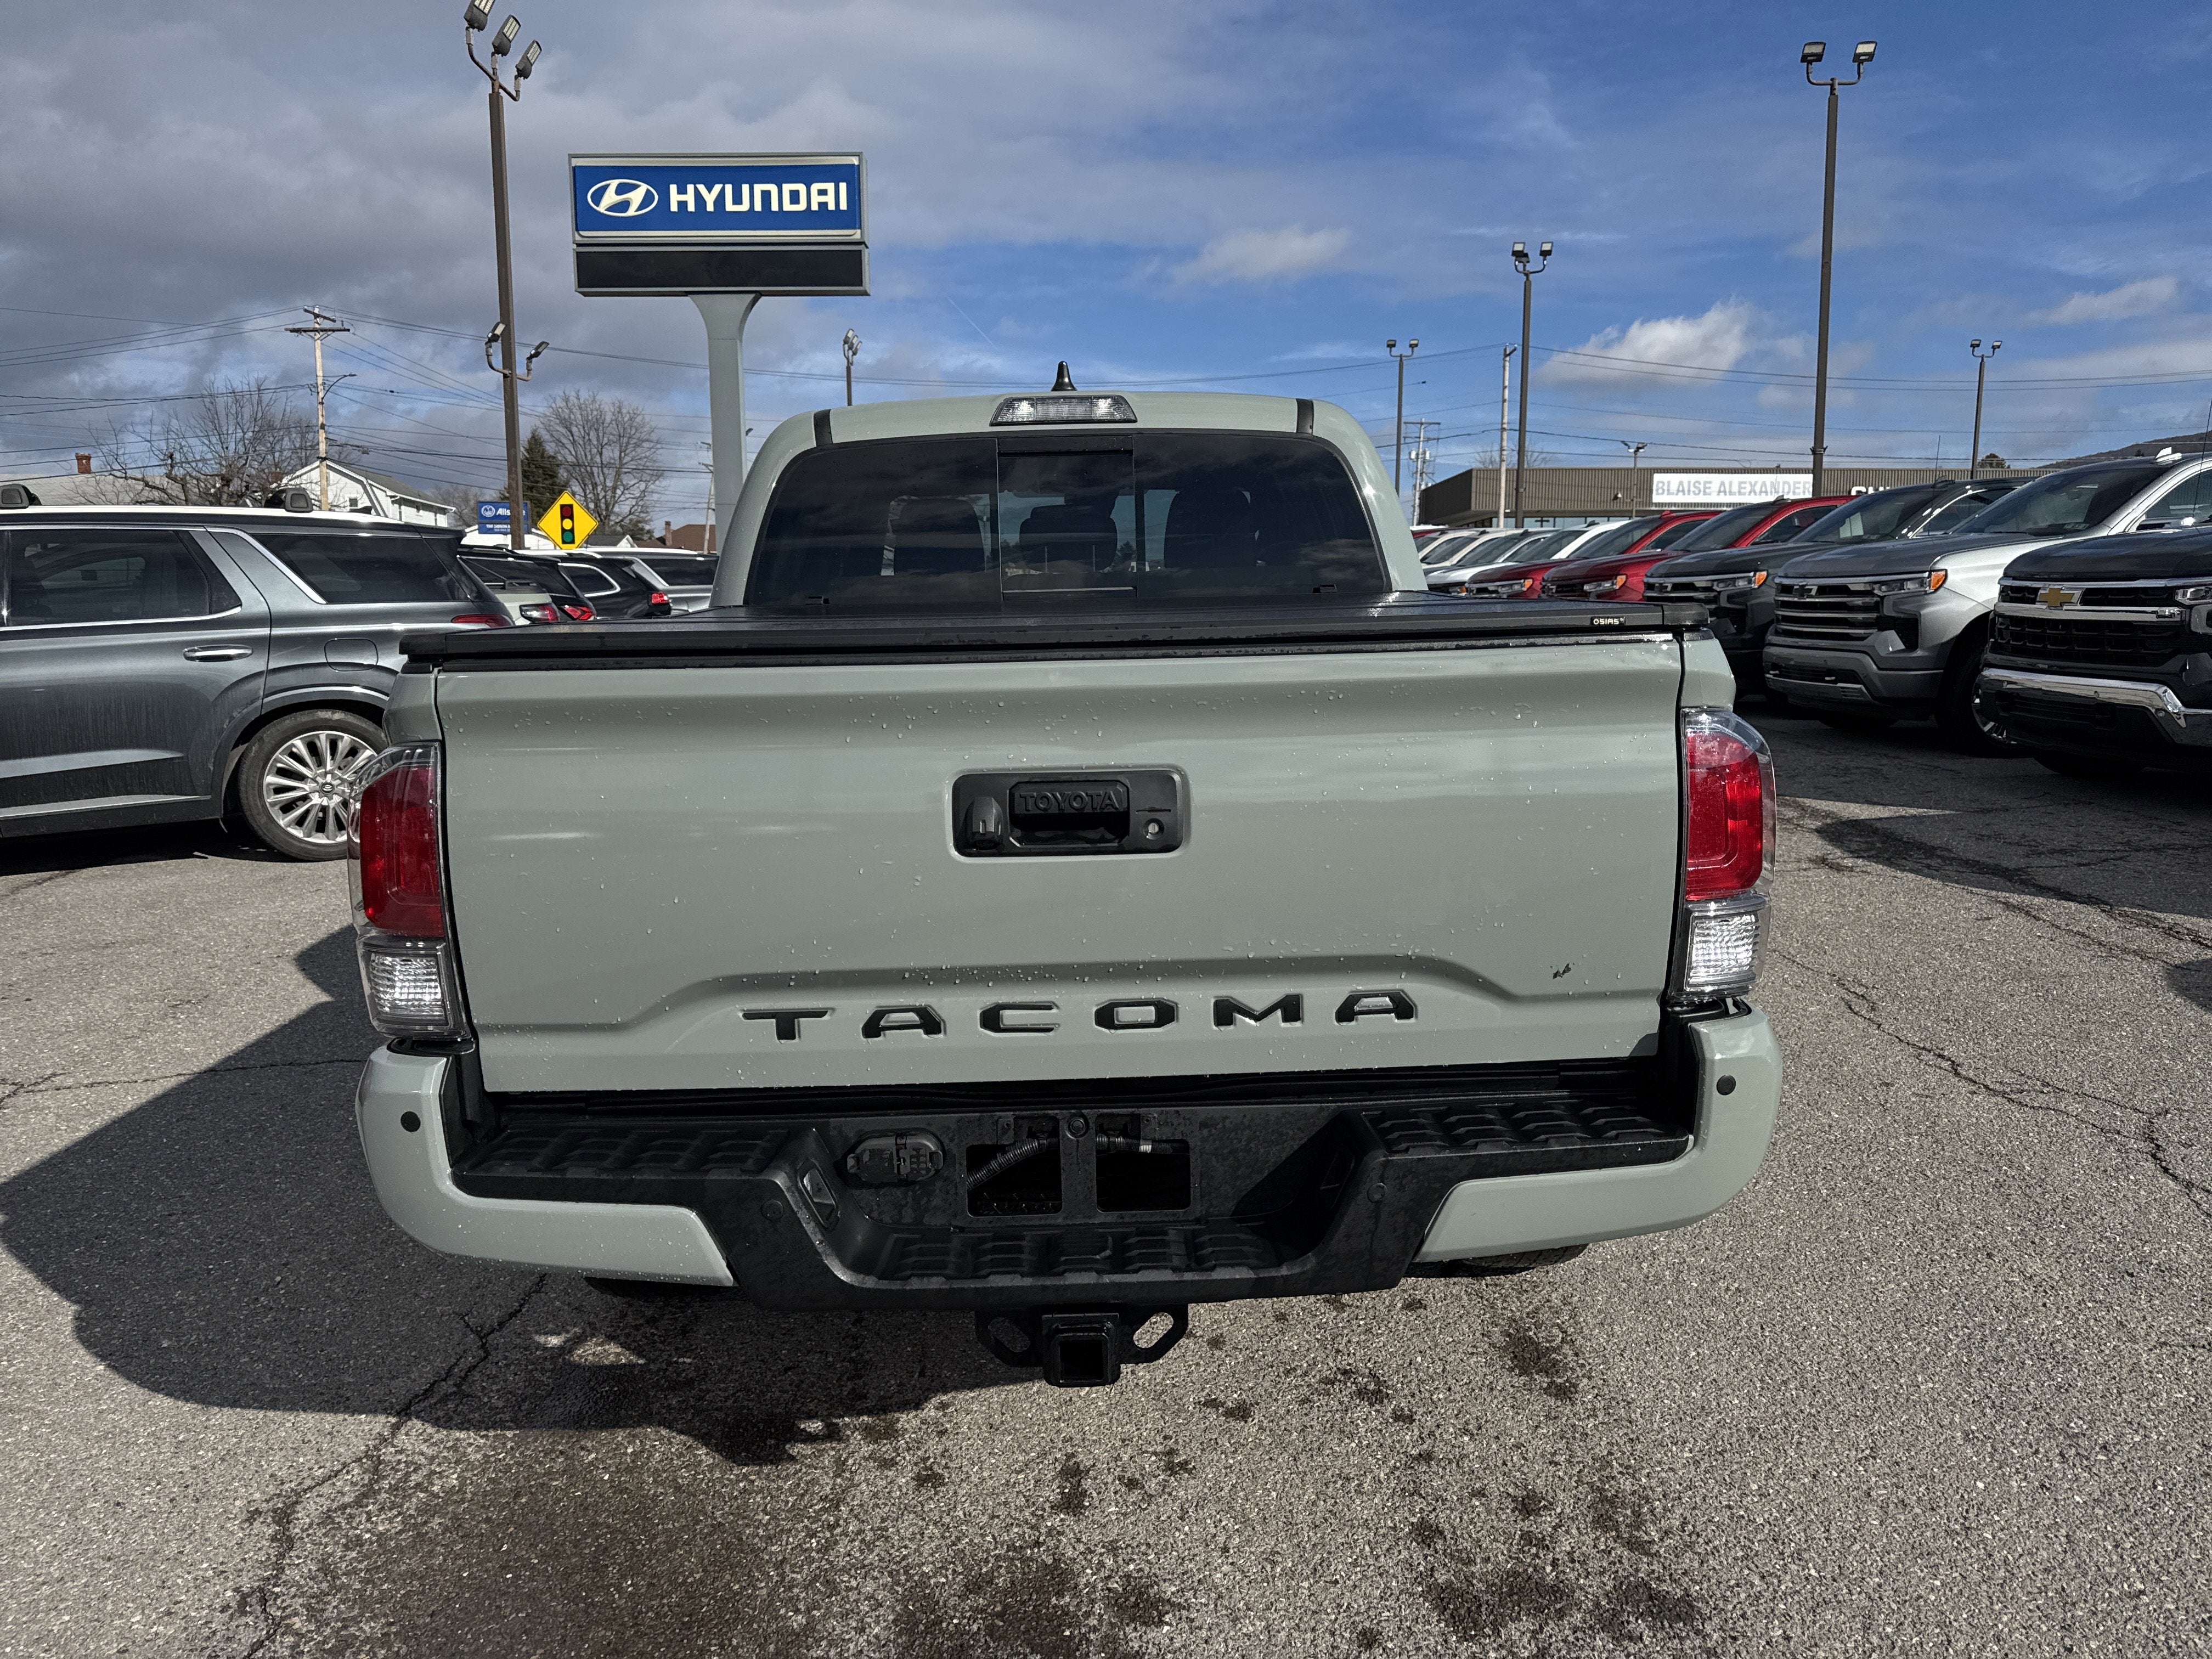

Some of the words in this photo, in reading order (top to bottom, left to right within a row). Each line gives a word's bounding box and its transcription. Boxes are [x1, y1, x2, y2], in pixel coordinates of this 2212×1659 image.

[669, 182, 848, 212] HYUNDAI
[1655, 481, 1712, 496] BLAISE
[1716, 481, 1813, 496] ALEXANDER
[1019, 791, 1120, 812] TOYOTA
[741, 990, 1419, 1042] TACOMA
